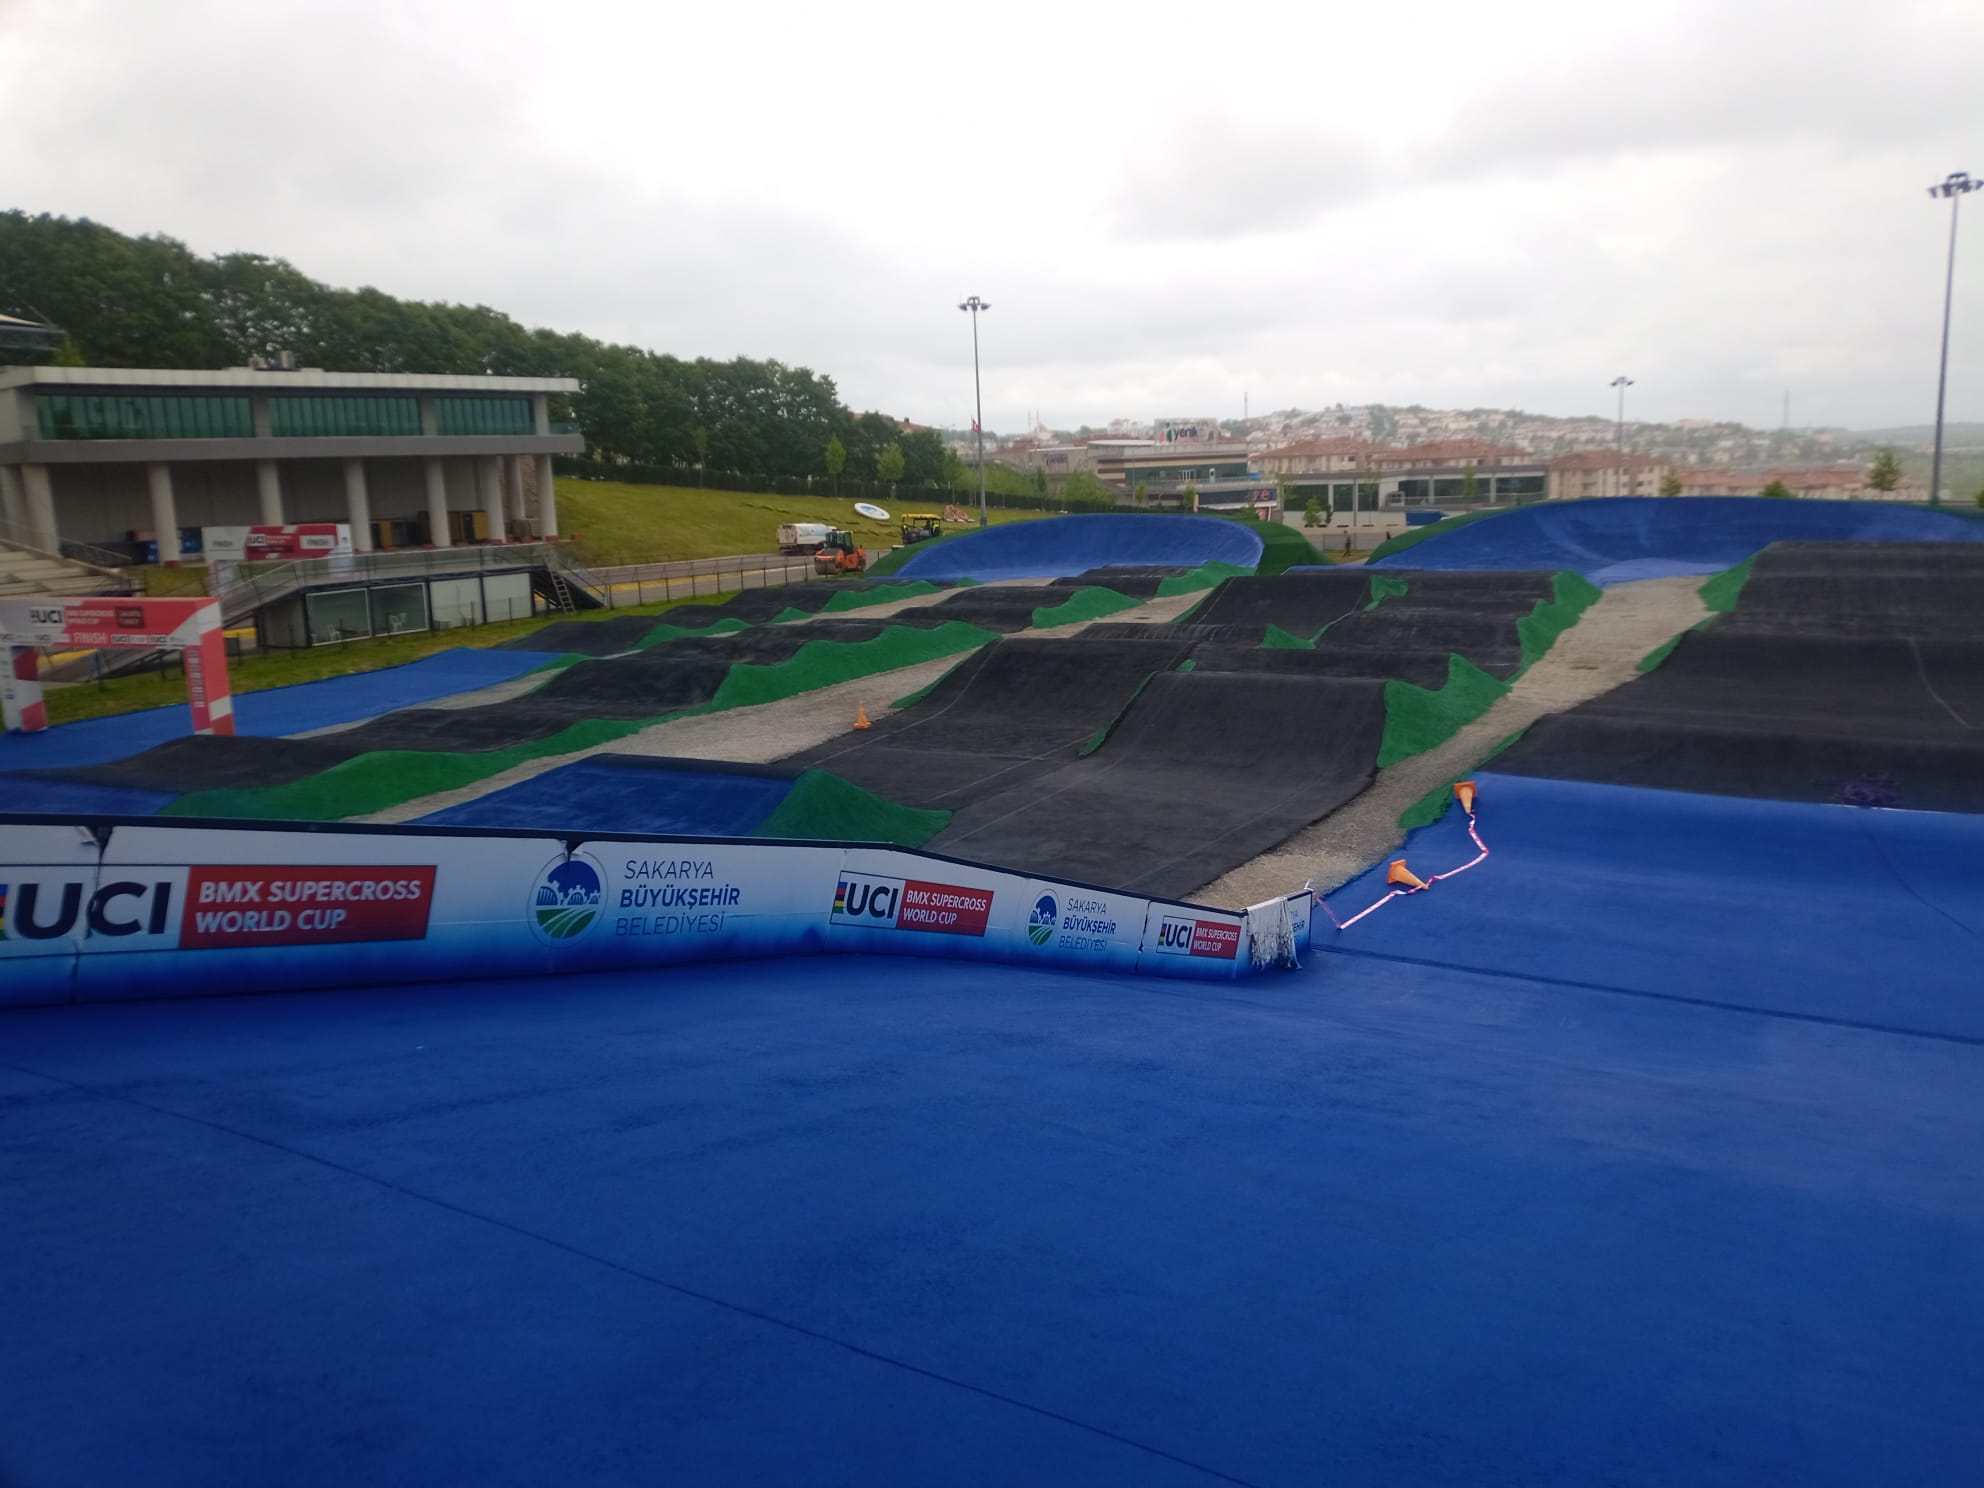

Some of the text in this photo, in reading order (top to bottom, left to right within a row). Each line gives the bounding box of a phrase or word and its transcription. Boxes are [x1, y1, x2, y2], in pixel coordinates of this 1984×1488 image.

[36, 610, 62, 624] UCI
[73, 632, 107, 644] FINISH
[624, 860, 714, 880] SAKARYA
[199, 880, 421, 903] BMX SUPERCROSS
[619, 884, 741, 909] BÜYÜKŞEHİR
[846, 882, 899, 918] UCI
[906, 890, 987, 911] BMX SUPERCROSS
[14, 881, 172, 939] UCI
[903, 908, 957, 925] WORLD CUP
[1067, 898, 1107, 915] SAKARYA
[195, 908, 347, 934] WORLD CUP
[615, 914, 725, 937] BELEDİYESİ
[1062, 915, 1117, 935] BÜYÜKŞEHİR
[1165, 924, 1193, 949] UCI
[1195, 927, 1238, 942] BMX SUPERCROSS
[1193, 940, 1222, 953] WORLD CUP
